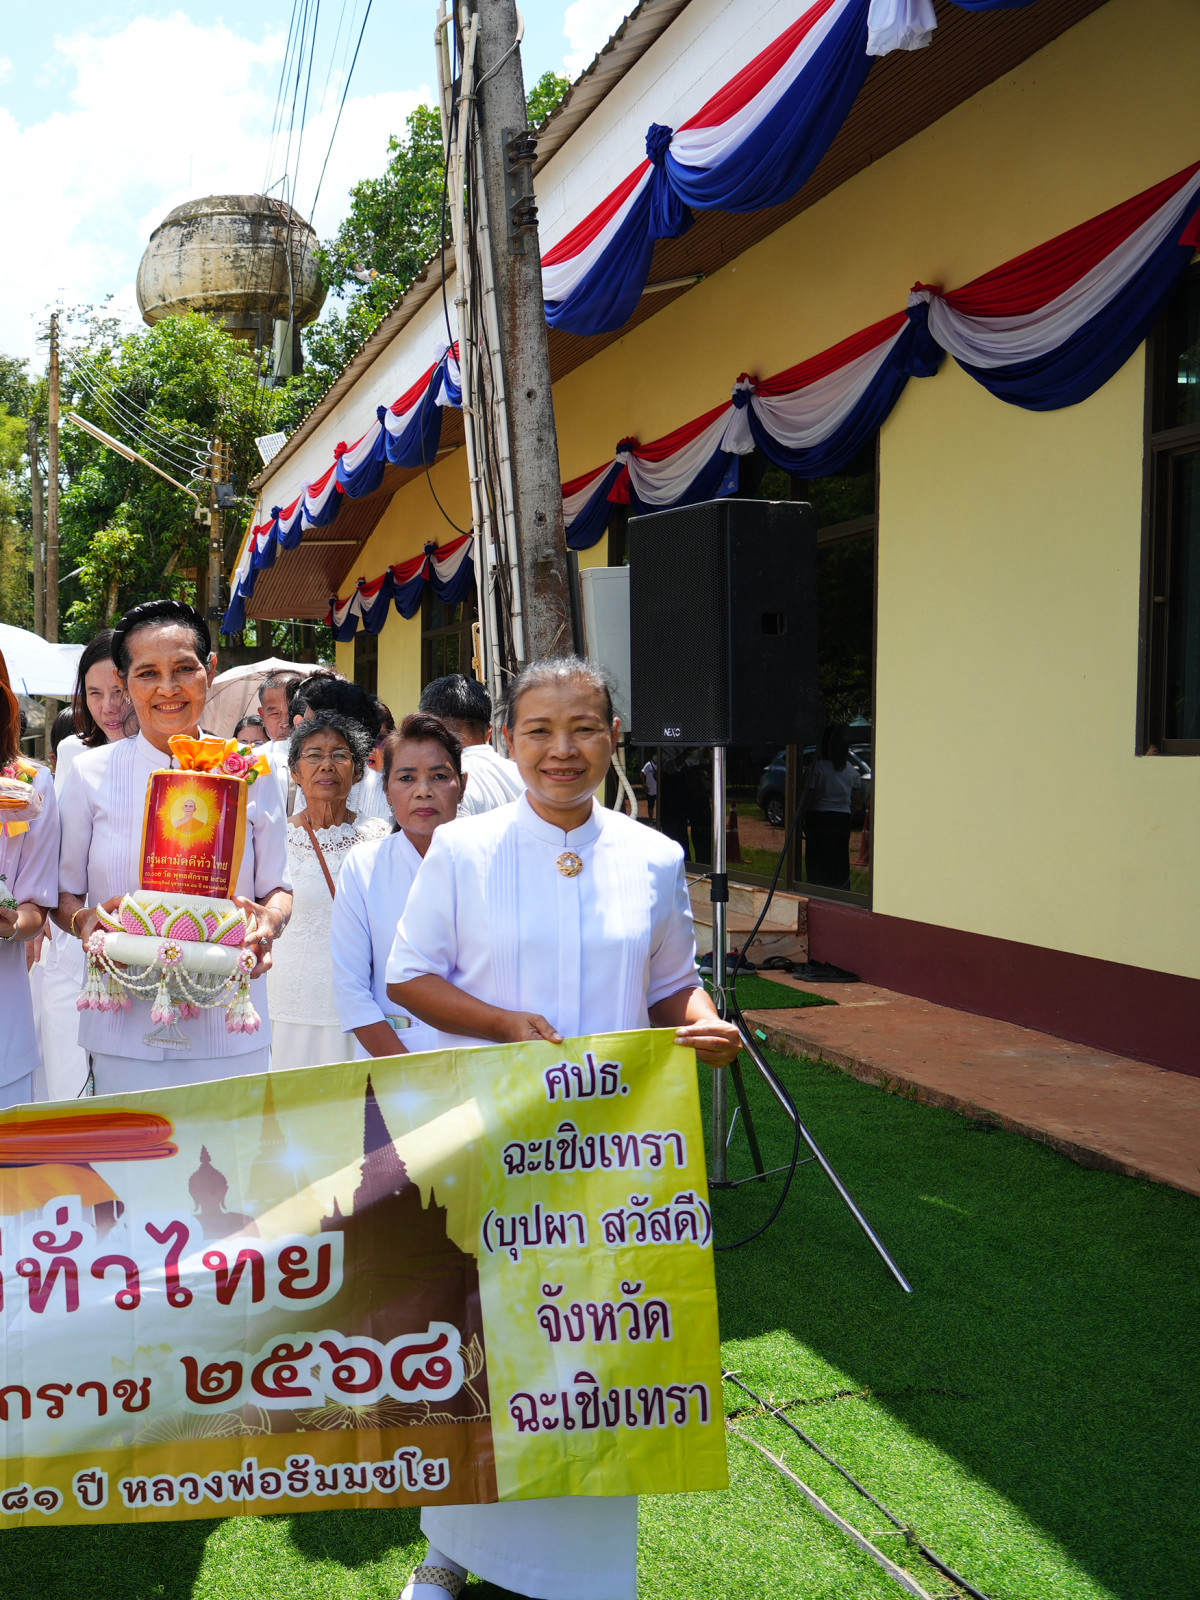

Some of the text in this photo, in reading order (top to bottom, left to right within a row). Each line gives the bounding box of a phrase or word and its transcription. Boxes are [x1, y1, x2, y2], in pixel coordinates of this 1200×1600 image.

[664, 727, 680, 737] NEXO
[545, 1053, 628, 1099] ศปธ.
[503, 1122, 685, 1175] ฉะเชิงเทรา
[482, 1192, 713, 1261] (บุปผา สวัสดี)
[537, 1282, 671, 1344] จังหวัด
[179, 1333, 454, 1404] ๒๕๖๘
[509, 1371, 710, 1433] ฉะเชิงเทรา
[77, 1470, 104, 1508] ปี
[122, 1451, 450, 1504] หลวงพ่อธัมมชโย
